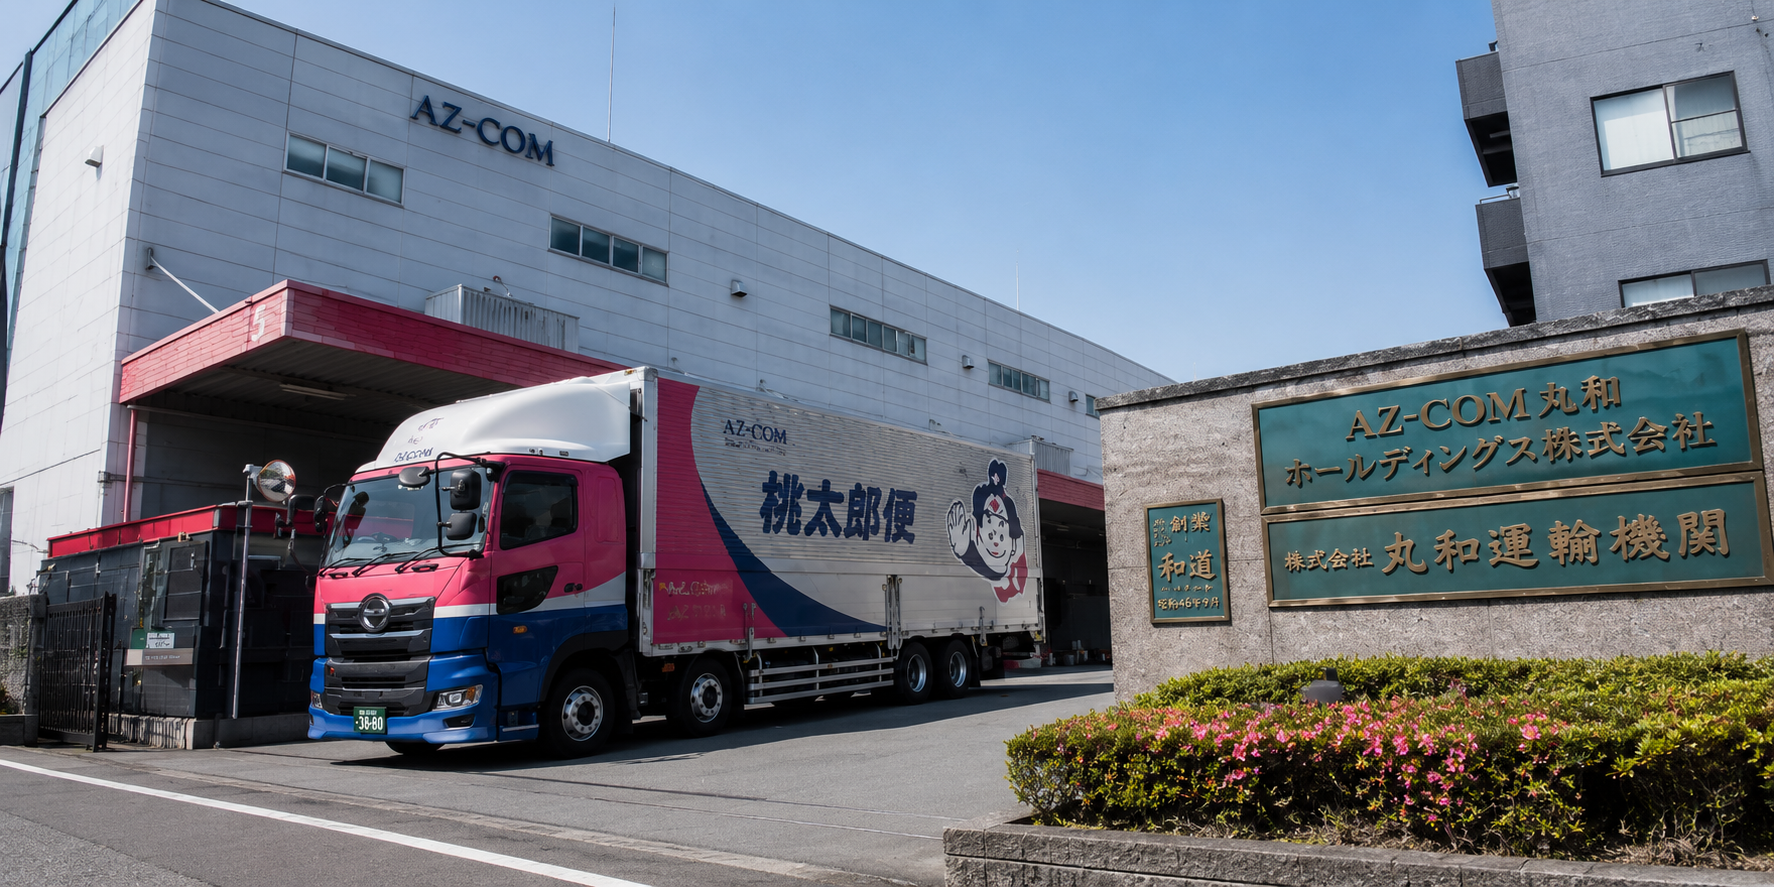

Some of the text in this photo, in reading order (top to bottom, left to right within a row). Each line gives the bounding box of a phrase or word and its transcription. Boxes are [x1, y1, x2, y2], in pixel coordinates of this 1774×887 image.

[410, 95, 555, 166] AZ-COM
[251, 304, 266, 342] 5
[723, 419, 787, 445] AZ-COM
[1346, 375, 1621, 441] AZ-COM 丸和
[1284, 411, 1717, 487] ホールディングス株式会社
[760, 470, 917, 544] 桃太郎便
[1158, 549, 1217, 582] 和道
[1284, 508, 1730, 574] 株式会社 丸和運輸機関
